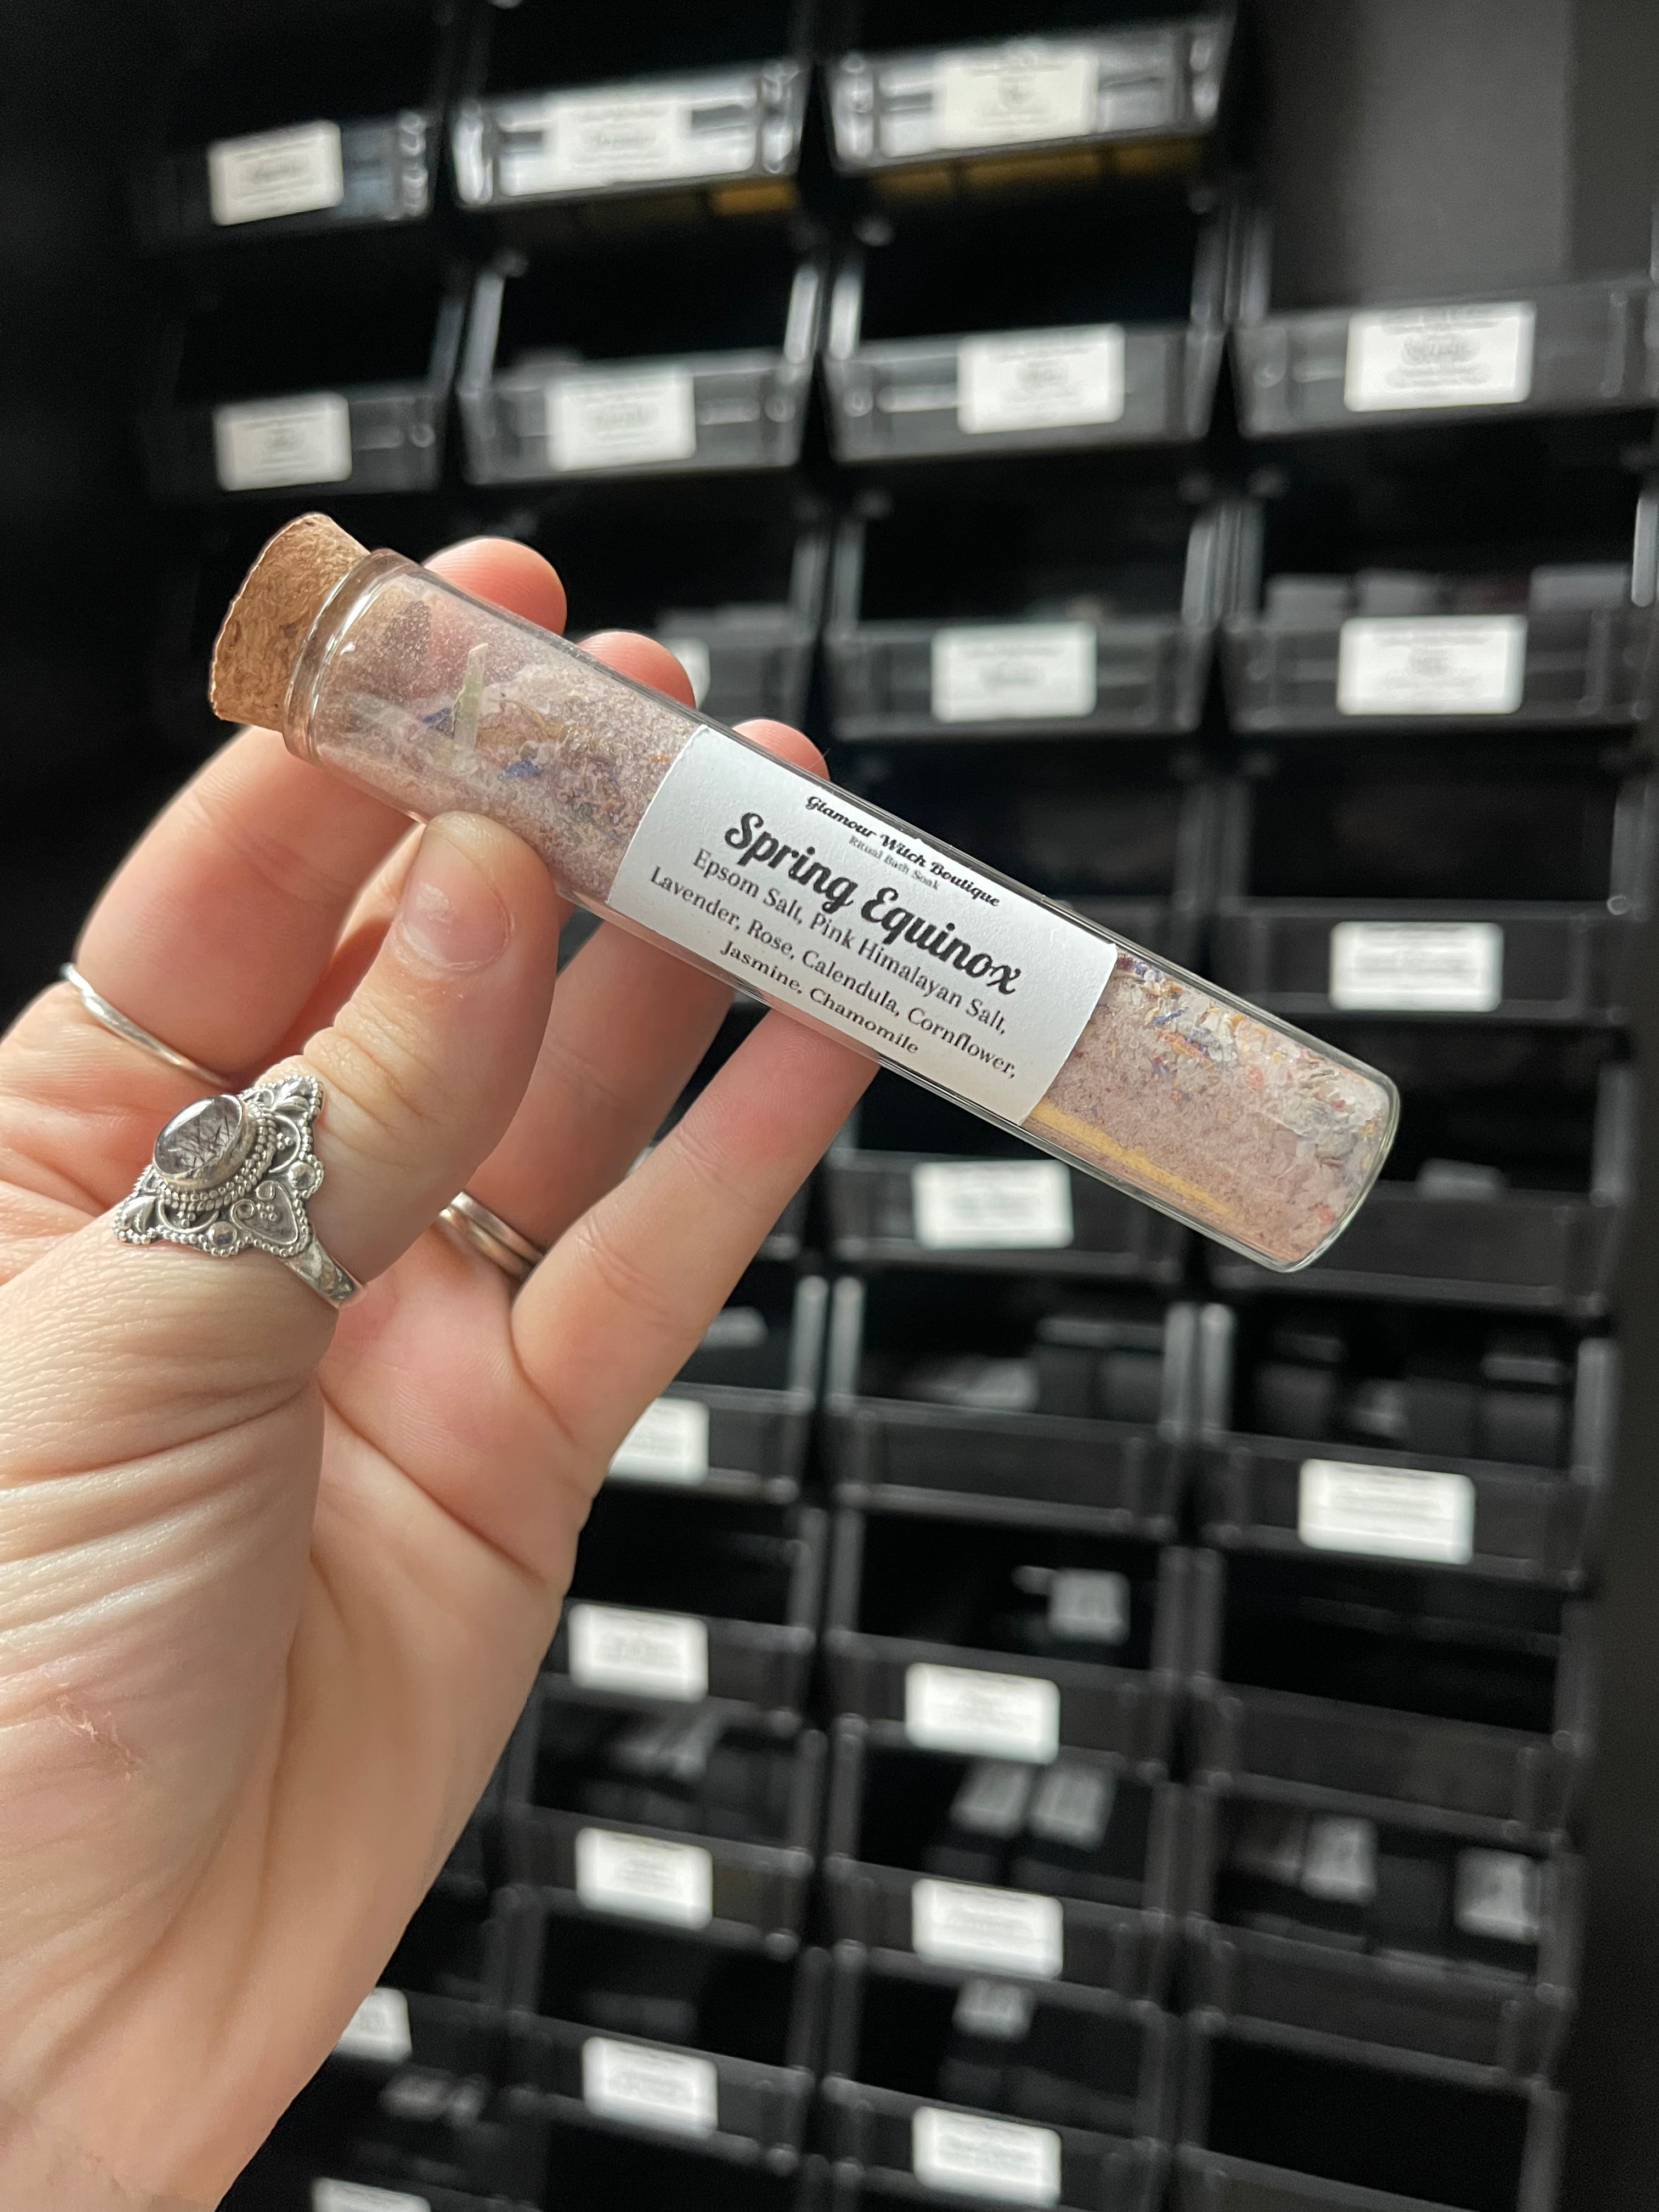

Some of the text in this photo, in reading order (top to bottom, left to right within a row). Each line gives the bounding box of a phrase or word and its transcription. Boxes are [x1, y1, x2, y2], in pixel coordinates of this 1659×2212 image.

[724, 812, 1022, 995] Spring Equinox
[805, 796, 1000, 907] Glamour Witch Boutique
[884, 855, 910, 875] Bath
[911, 870, 939, 890] Soak
[651, 865, 1014, 1079] Lavender, Rose, Calendula, Cornflower,
[693, 848, 1005, 1035] Epsom Salt, Pink Himalayan Salt,
[720, 940, 918, 1054] Jasmine, Chamomile
